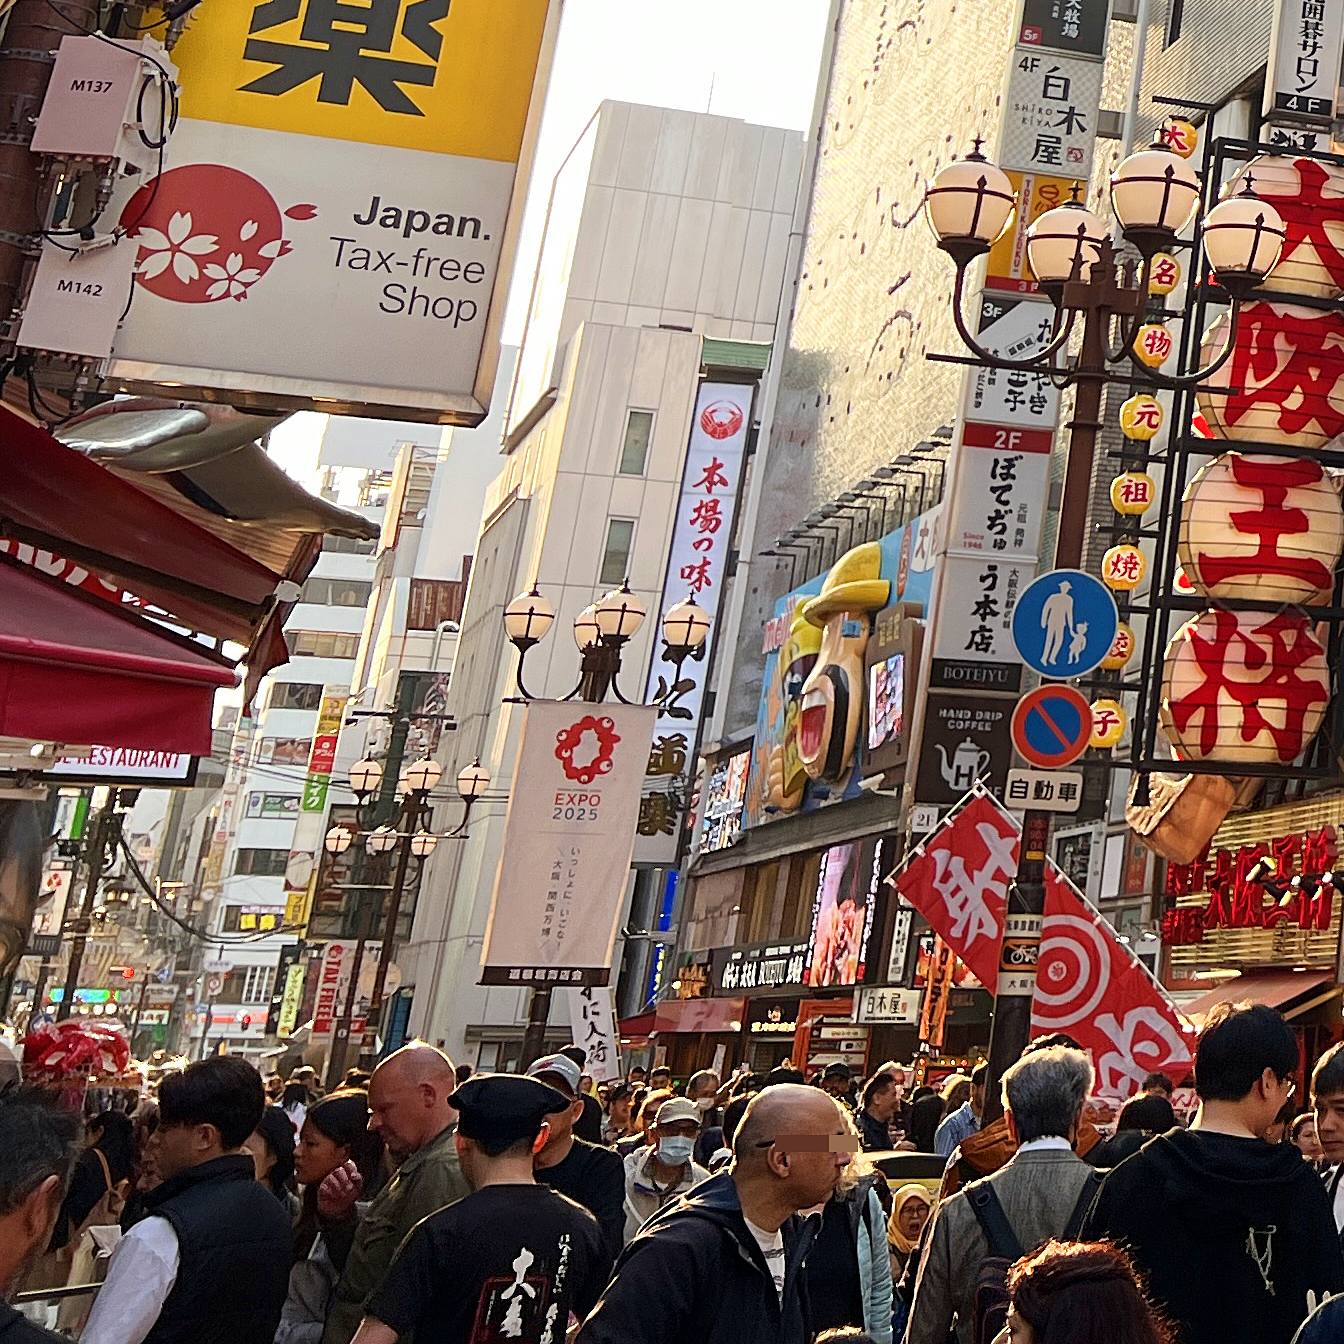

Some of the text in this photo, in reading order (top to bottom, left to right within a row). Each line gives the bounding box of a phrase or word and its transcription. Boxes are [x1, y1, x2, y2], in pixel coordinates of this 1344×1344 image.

[1018, 57, 1042, 74] 4F
[69, 77, 114, 94] M137
[1285, 96, 1322, 113] 4F
[1030, 65, 1089, 167] 白木屋
[352, 196, 492, 243] Japan.
[329, 236, 488, 286] Tax-free
[56, 279, 104, 299] M142
[377, 282, 479, 328] Shop
[982, 302, 1003, 318] 3F
[993, 429, 1024, 449] 2F
[679, 455, 729, 590] 本場の味
[942, 665, 1010, 683] BOTEJYU
[938, 707, 1003, 722] HAND DRIP
[947, 719, 992, 732] COFFEE
[554, 792, 602, 807] EXPO
[1009, 779, 1078, 803] 自動車
[551, 807, 599, 821] 2025
